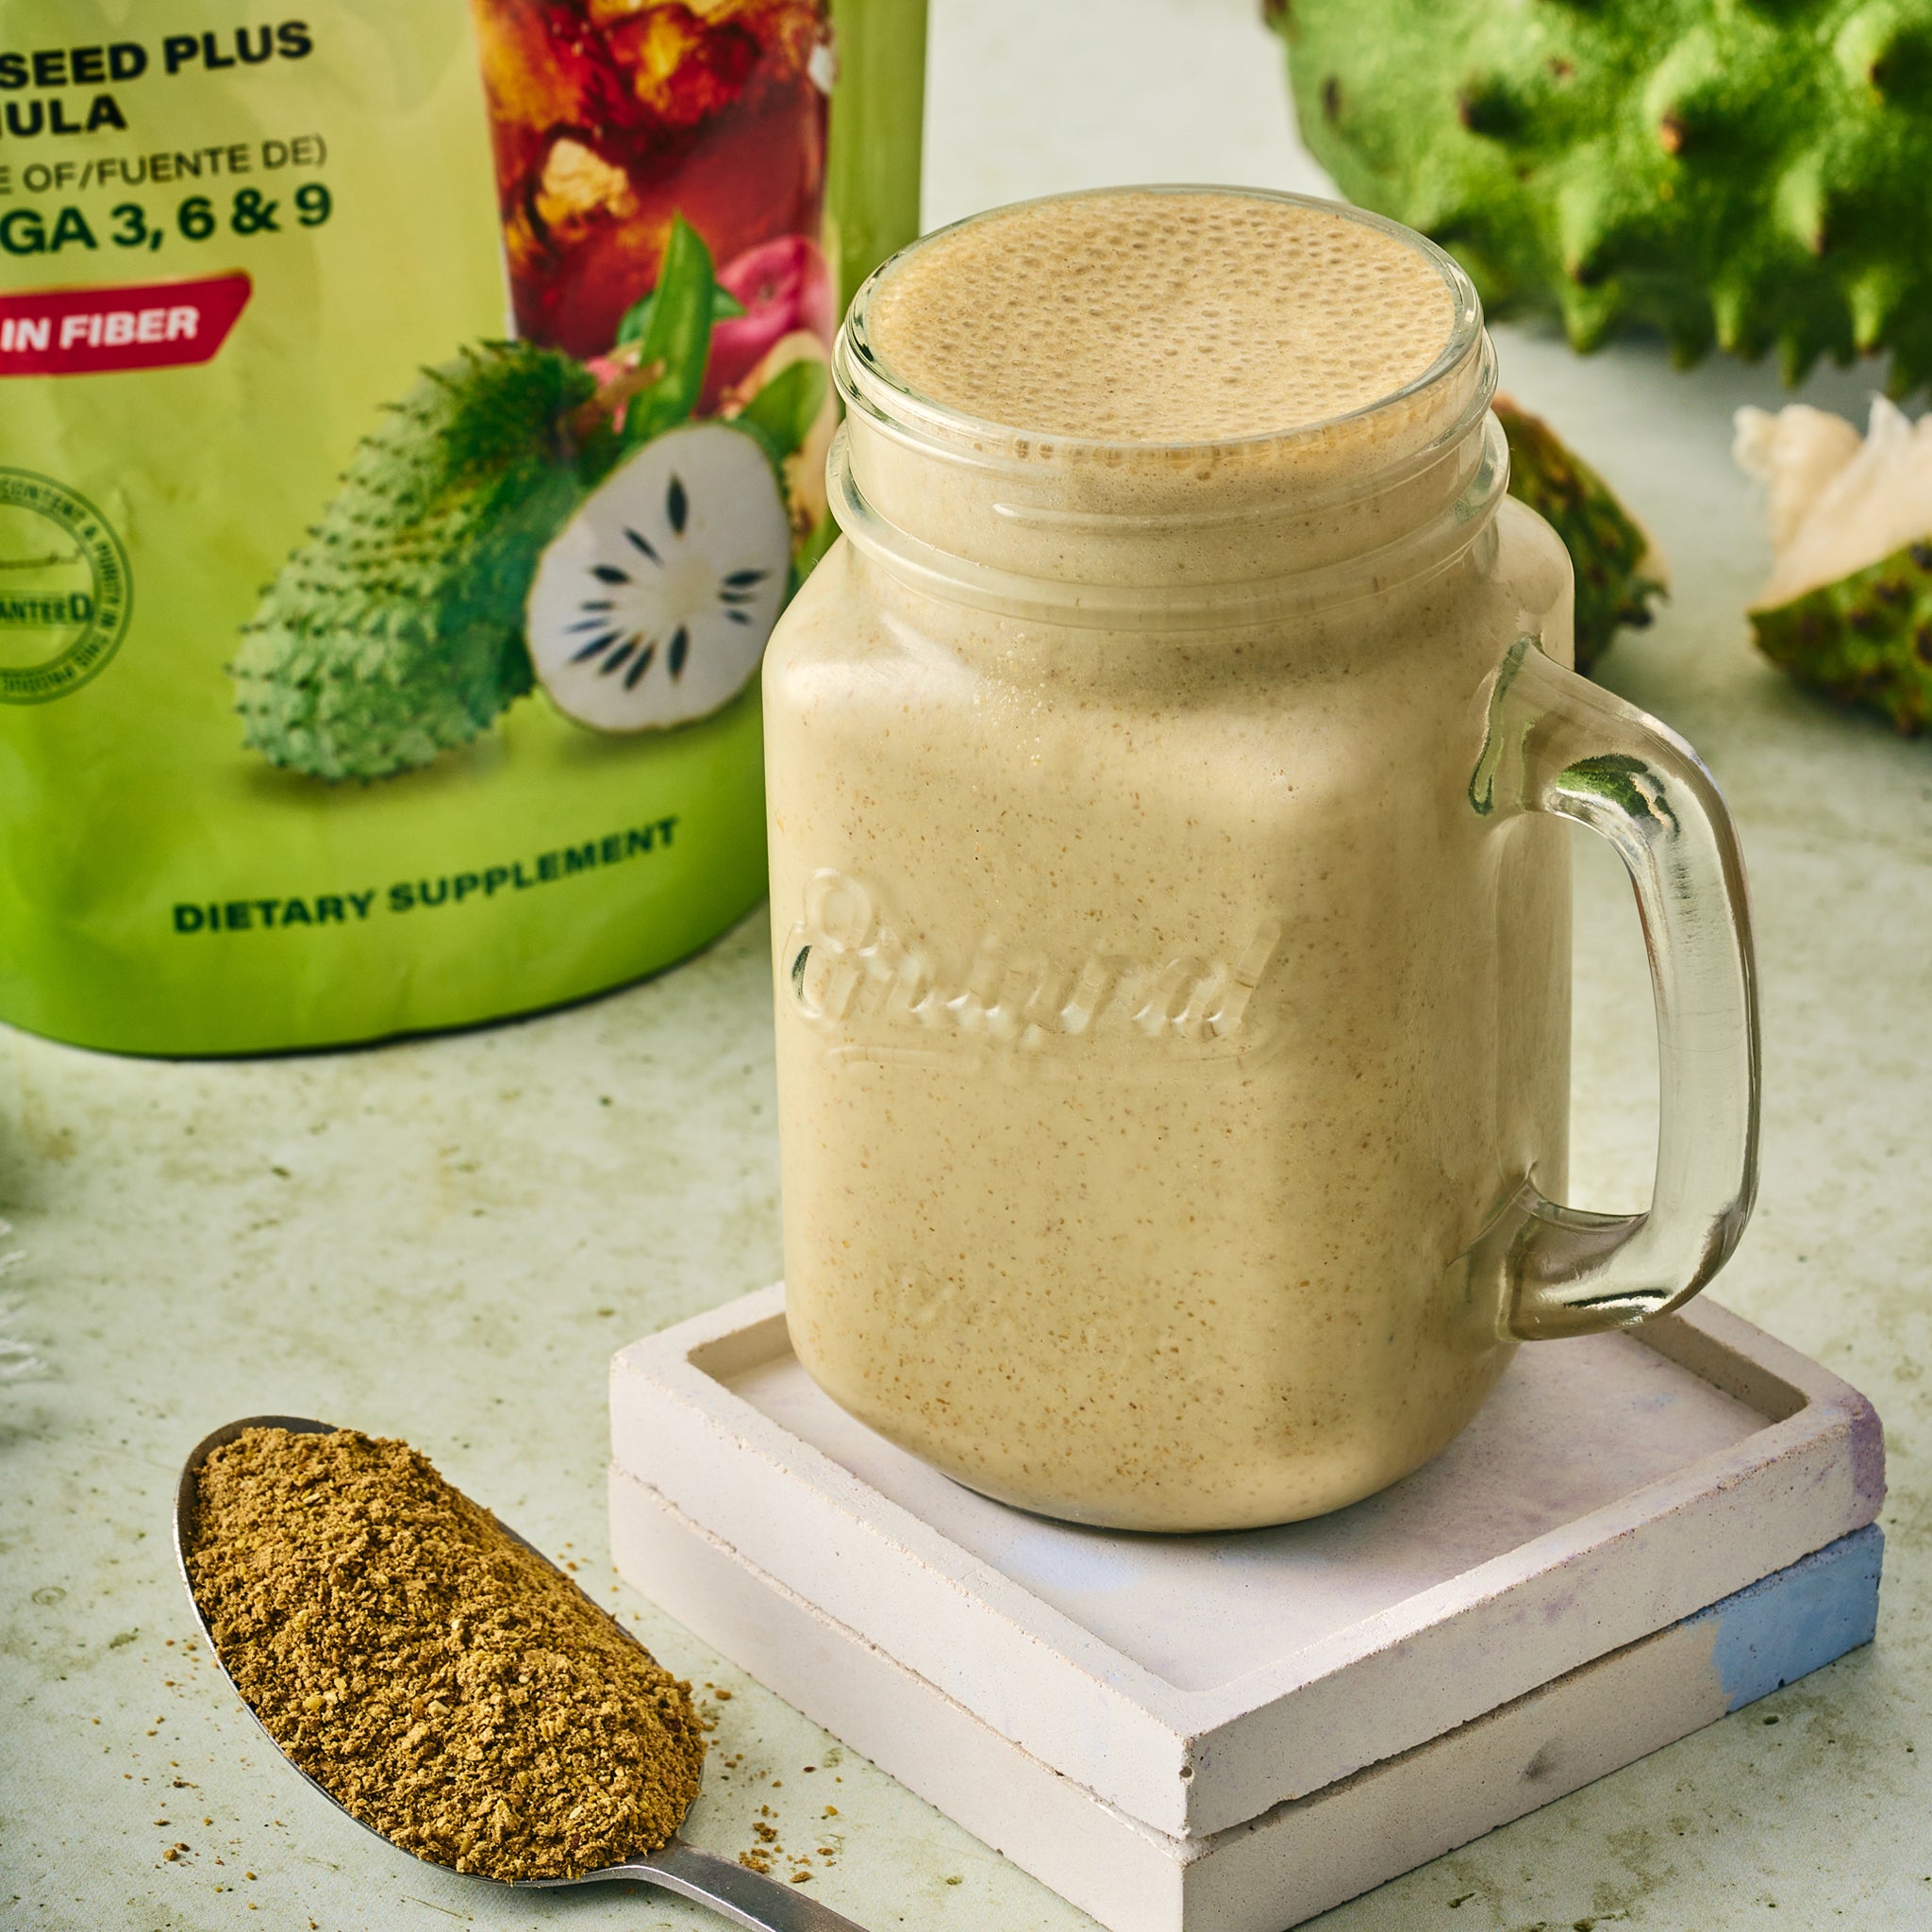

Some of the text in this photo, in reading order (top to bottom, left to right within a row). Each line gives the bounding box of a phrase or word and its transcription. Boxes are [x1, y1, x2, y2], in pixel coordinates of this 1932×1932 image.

[0, 21, 313, 90] SEED PLUS
[0, 93, 128, 139] ULA
[23, 142, 251, 193] OF/FUENTE
[262, 133, 327, 171] DE)
[109, 203, 164, 252] 3,
[177, 195, 216, 242] 6
[230, 187, 281, 236] &
[294, 182, 332, 228] 9
[1, 306, 200, 353] IN FIBER
[172, 815, 679, 935] DIETARY SUPPLEMENT
